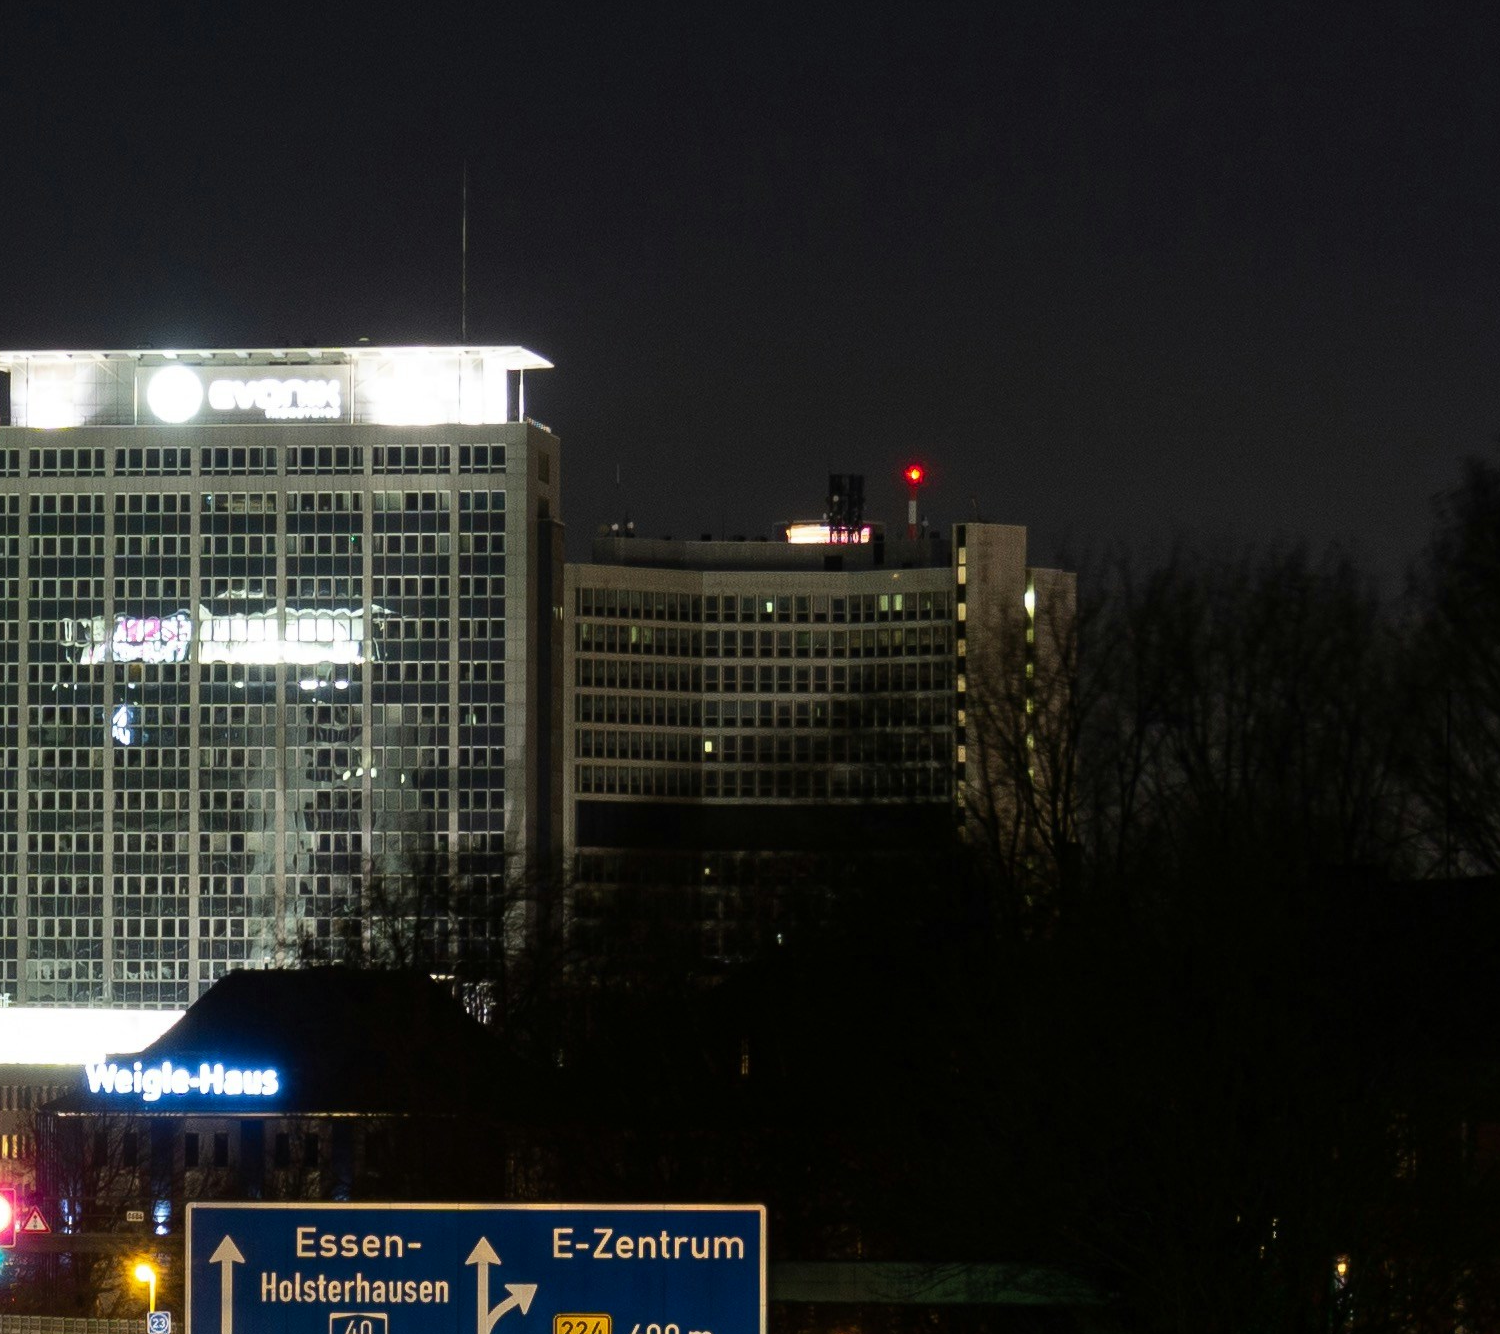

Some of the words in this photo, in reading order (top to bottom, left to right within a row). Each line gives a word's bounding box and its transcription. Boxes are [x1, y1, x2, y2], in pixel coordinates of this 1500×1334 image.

[85, 1061, 279, 1102] Weigle-Haus
[296, 1227, 422, 1258] Essen-
[552, 1228, 745, 1260] E-Zentrum
[260, 1272, 449, 1304] Holsterhausen
[152, 1318, 165, 1328] 23
